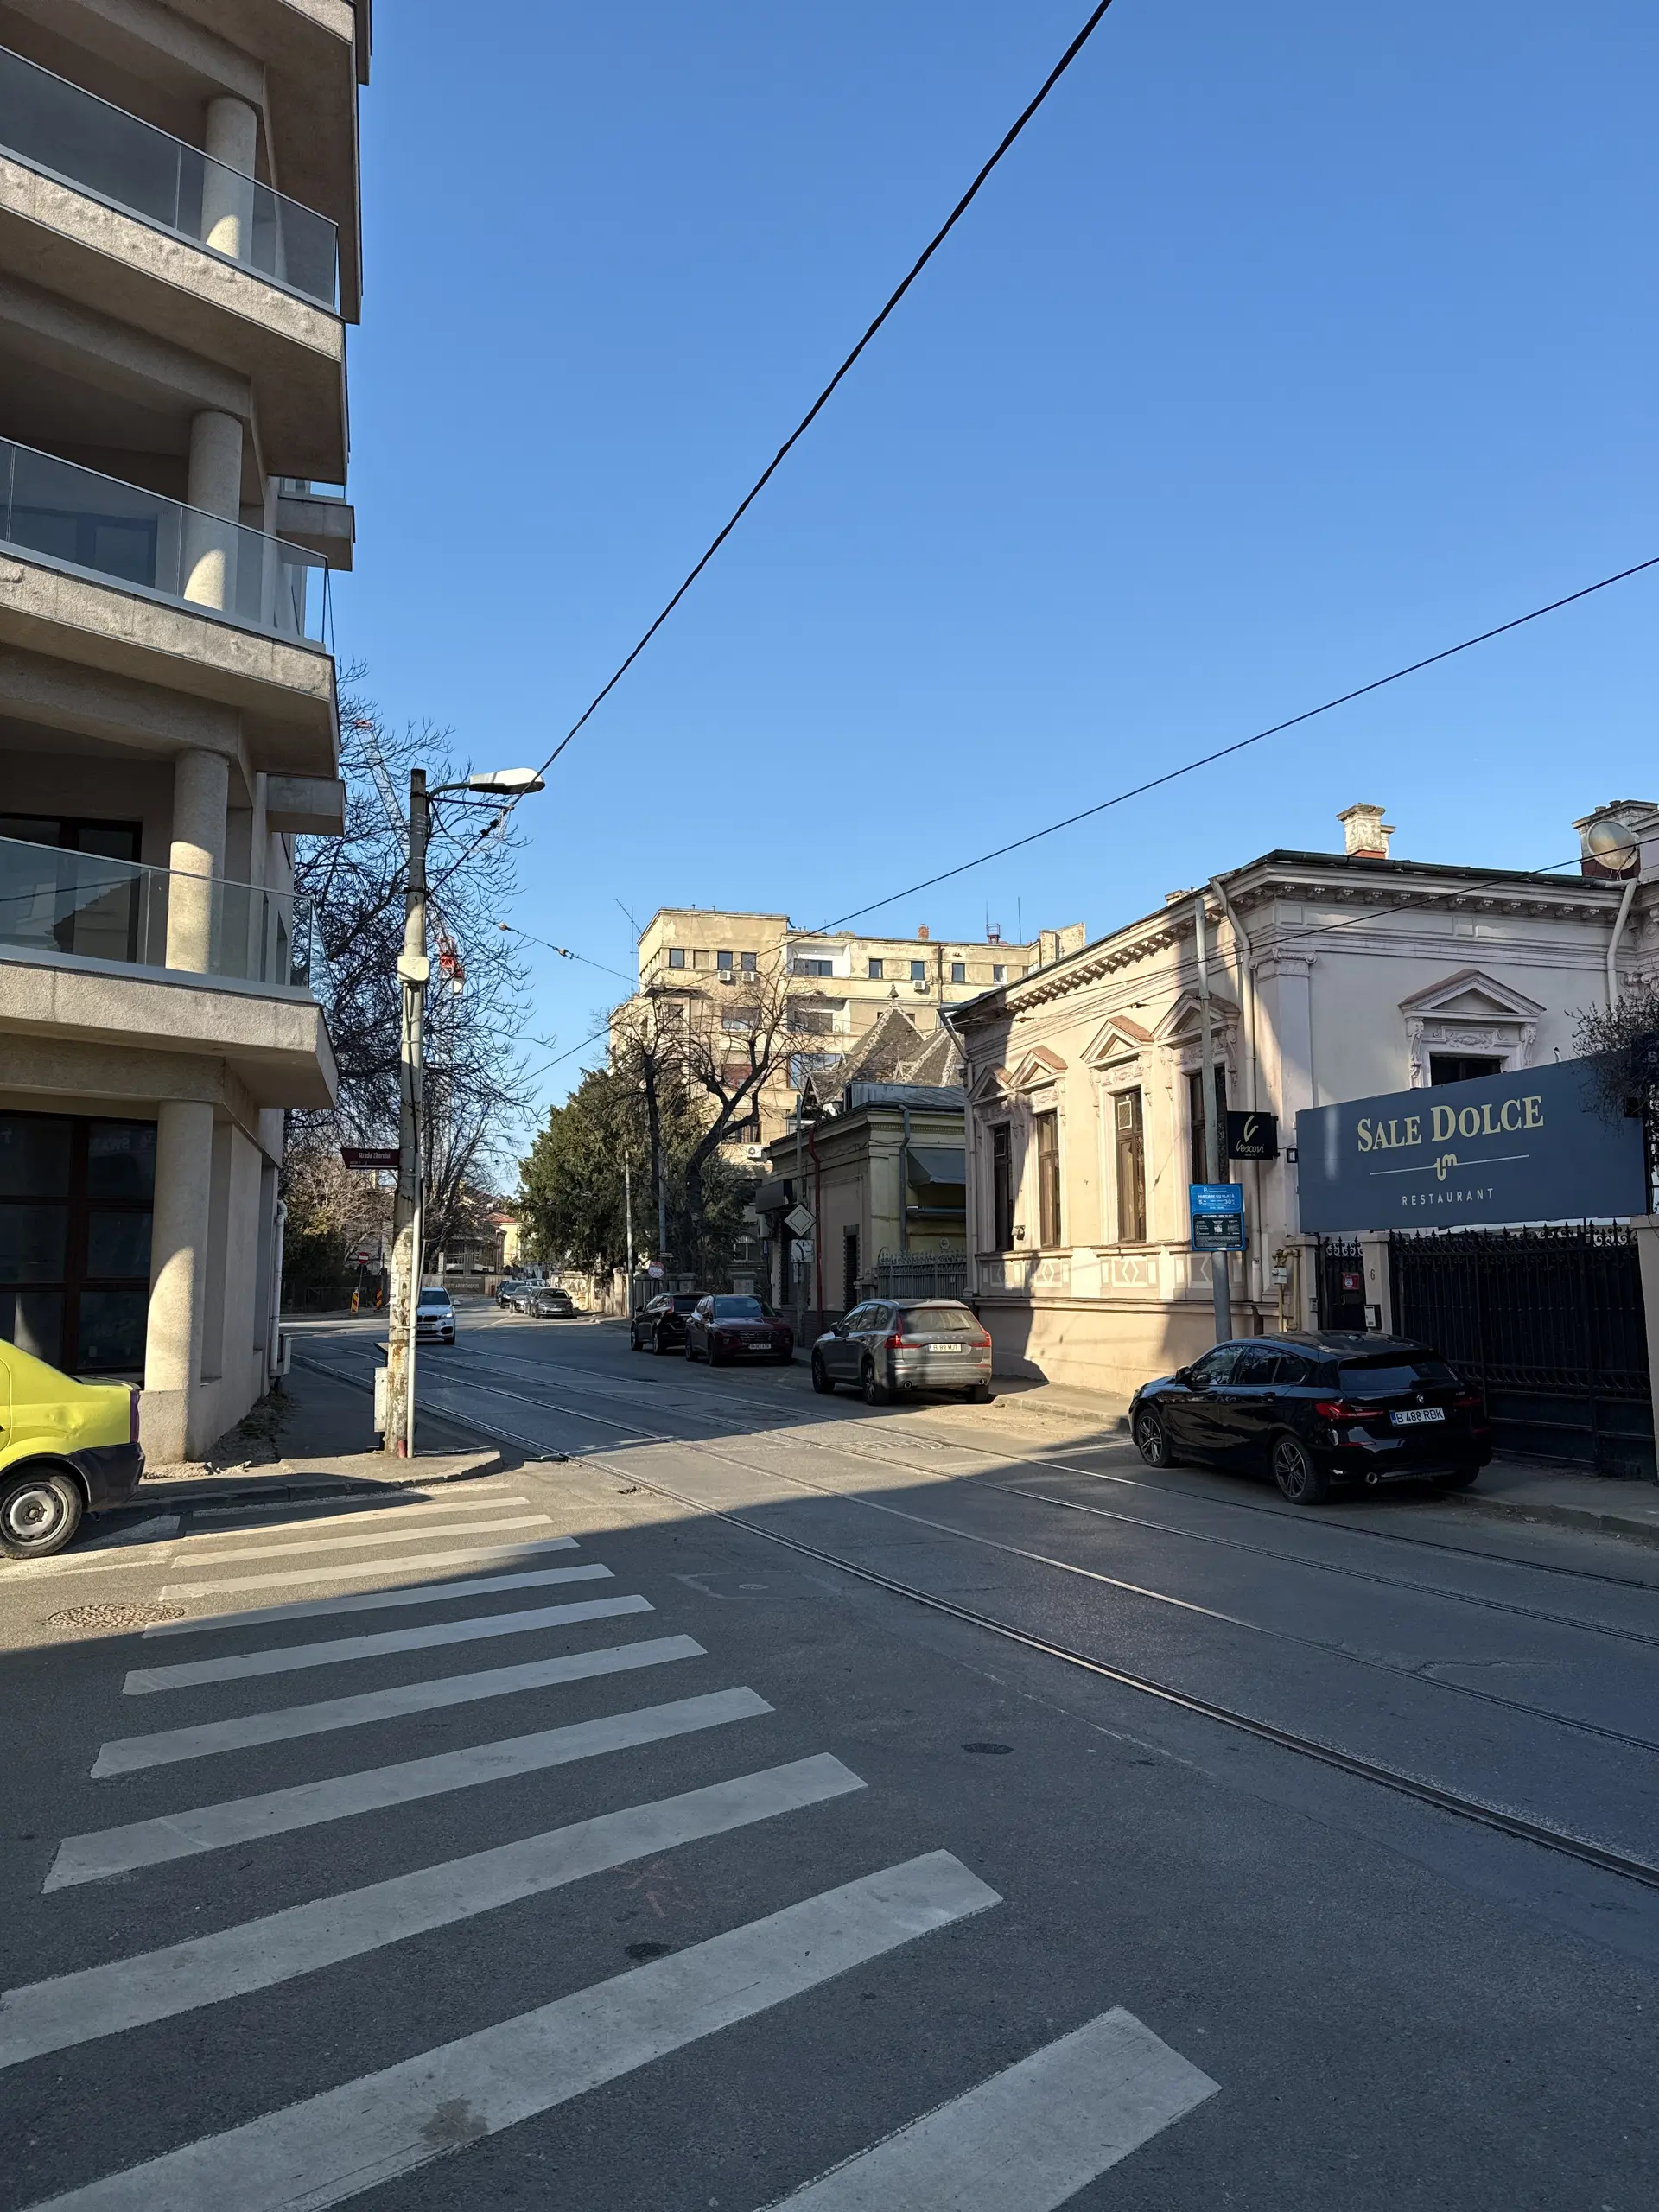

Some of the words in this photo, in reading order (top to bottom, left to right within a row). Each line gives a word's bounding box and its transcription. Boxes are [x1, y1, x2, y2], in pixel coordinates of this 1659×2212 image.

[1357, 1116, 1422, 1152] SALE
[1430, 1095, 1544, 1142] DOLCE
[1236, 1139, 1265, 1153] Vescovi
[1402, 1188, 1494, 1206] RESTAURANT
[1370, 1268, 1376, 1281] 6
[1395, 1413, 1403, 1423] B
[1406, 1411, 1422, 1421] 488
[1423, 1408, 1444, 1420] RBK
